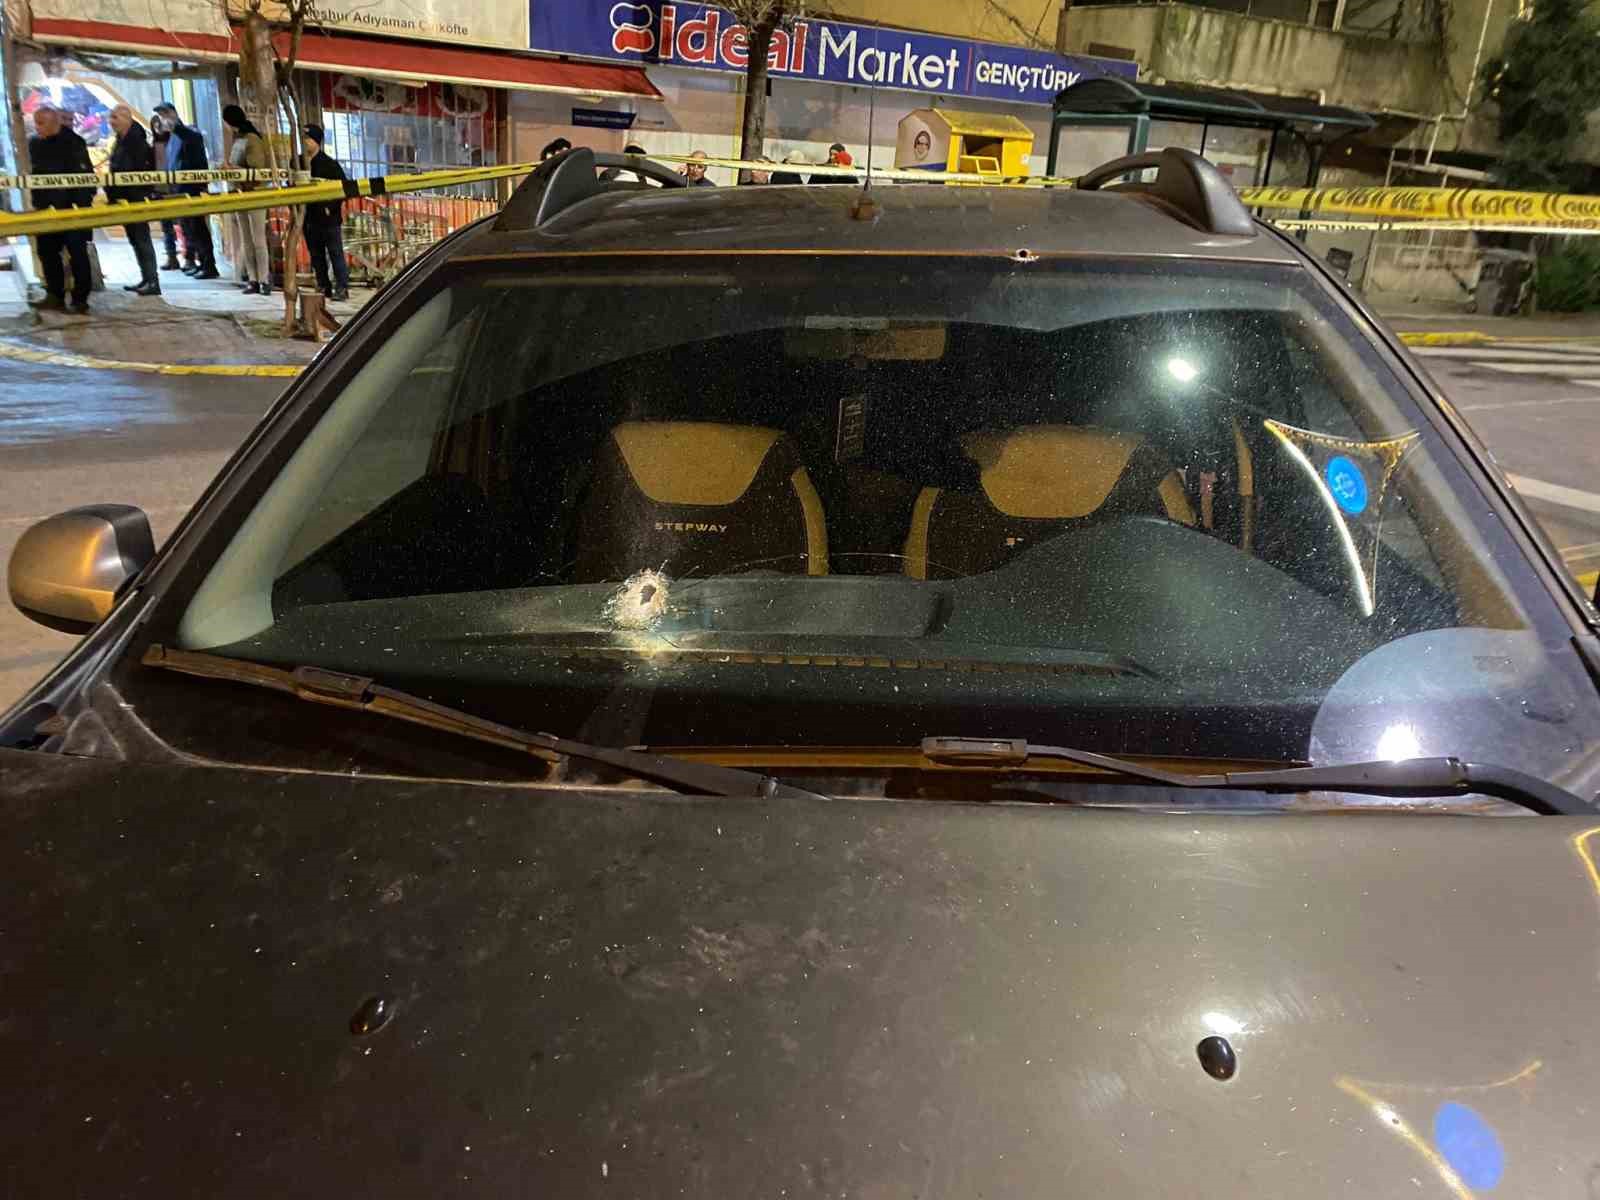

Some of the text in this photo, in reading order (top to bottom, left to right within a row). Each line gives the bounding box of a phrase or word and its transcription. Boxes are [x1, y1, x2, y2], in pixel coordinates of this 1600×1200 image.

[657, 4, 960, 90] ideal Market
[655, 521, 728, 533] STEPWAY
